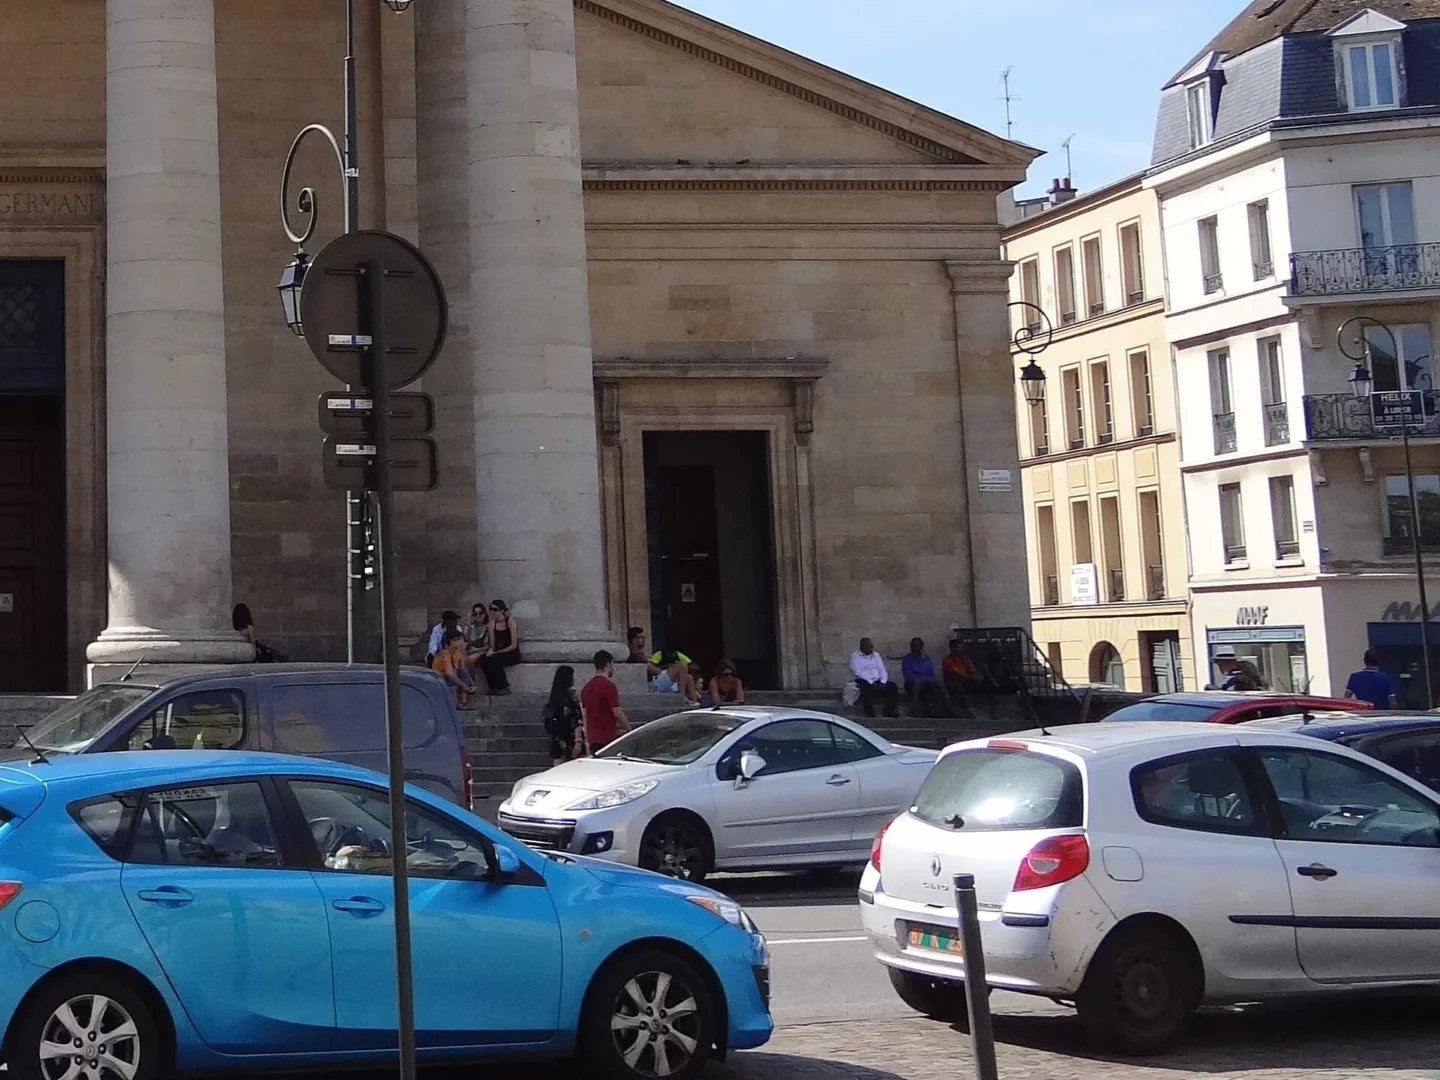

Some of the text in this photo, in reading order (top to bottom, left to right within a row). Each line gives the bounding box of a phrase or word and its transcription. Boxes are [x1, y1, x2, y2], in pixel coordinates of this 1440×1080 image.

[1381, 393, 1412, 401] HELIX
[1236, 605, 1269, 626] MAAF
[923, 882, 949, 891] CLIO
